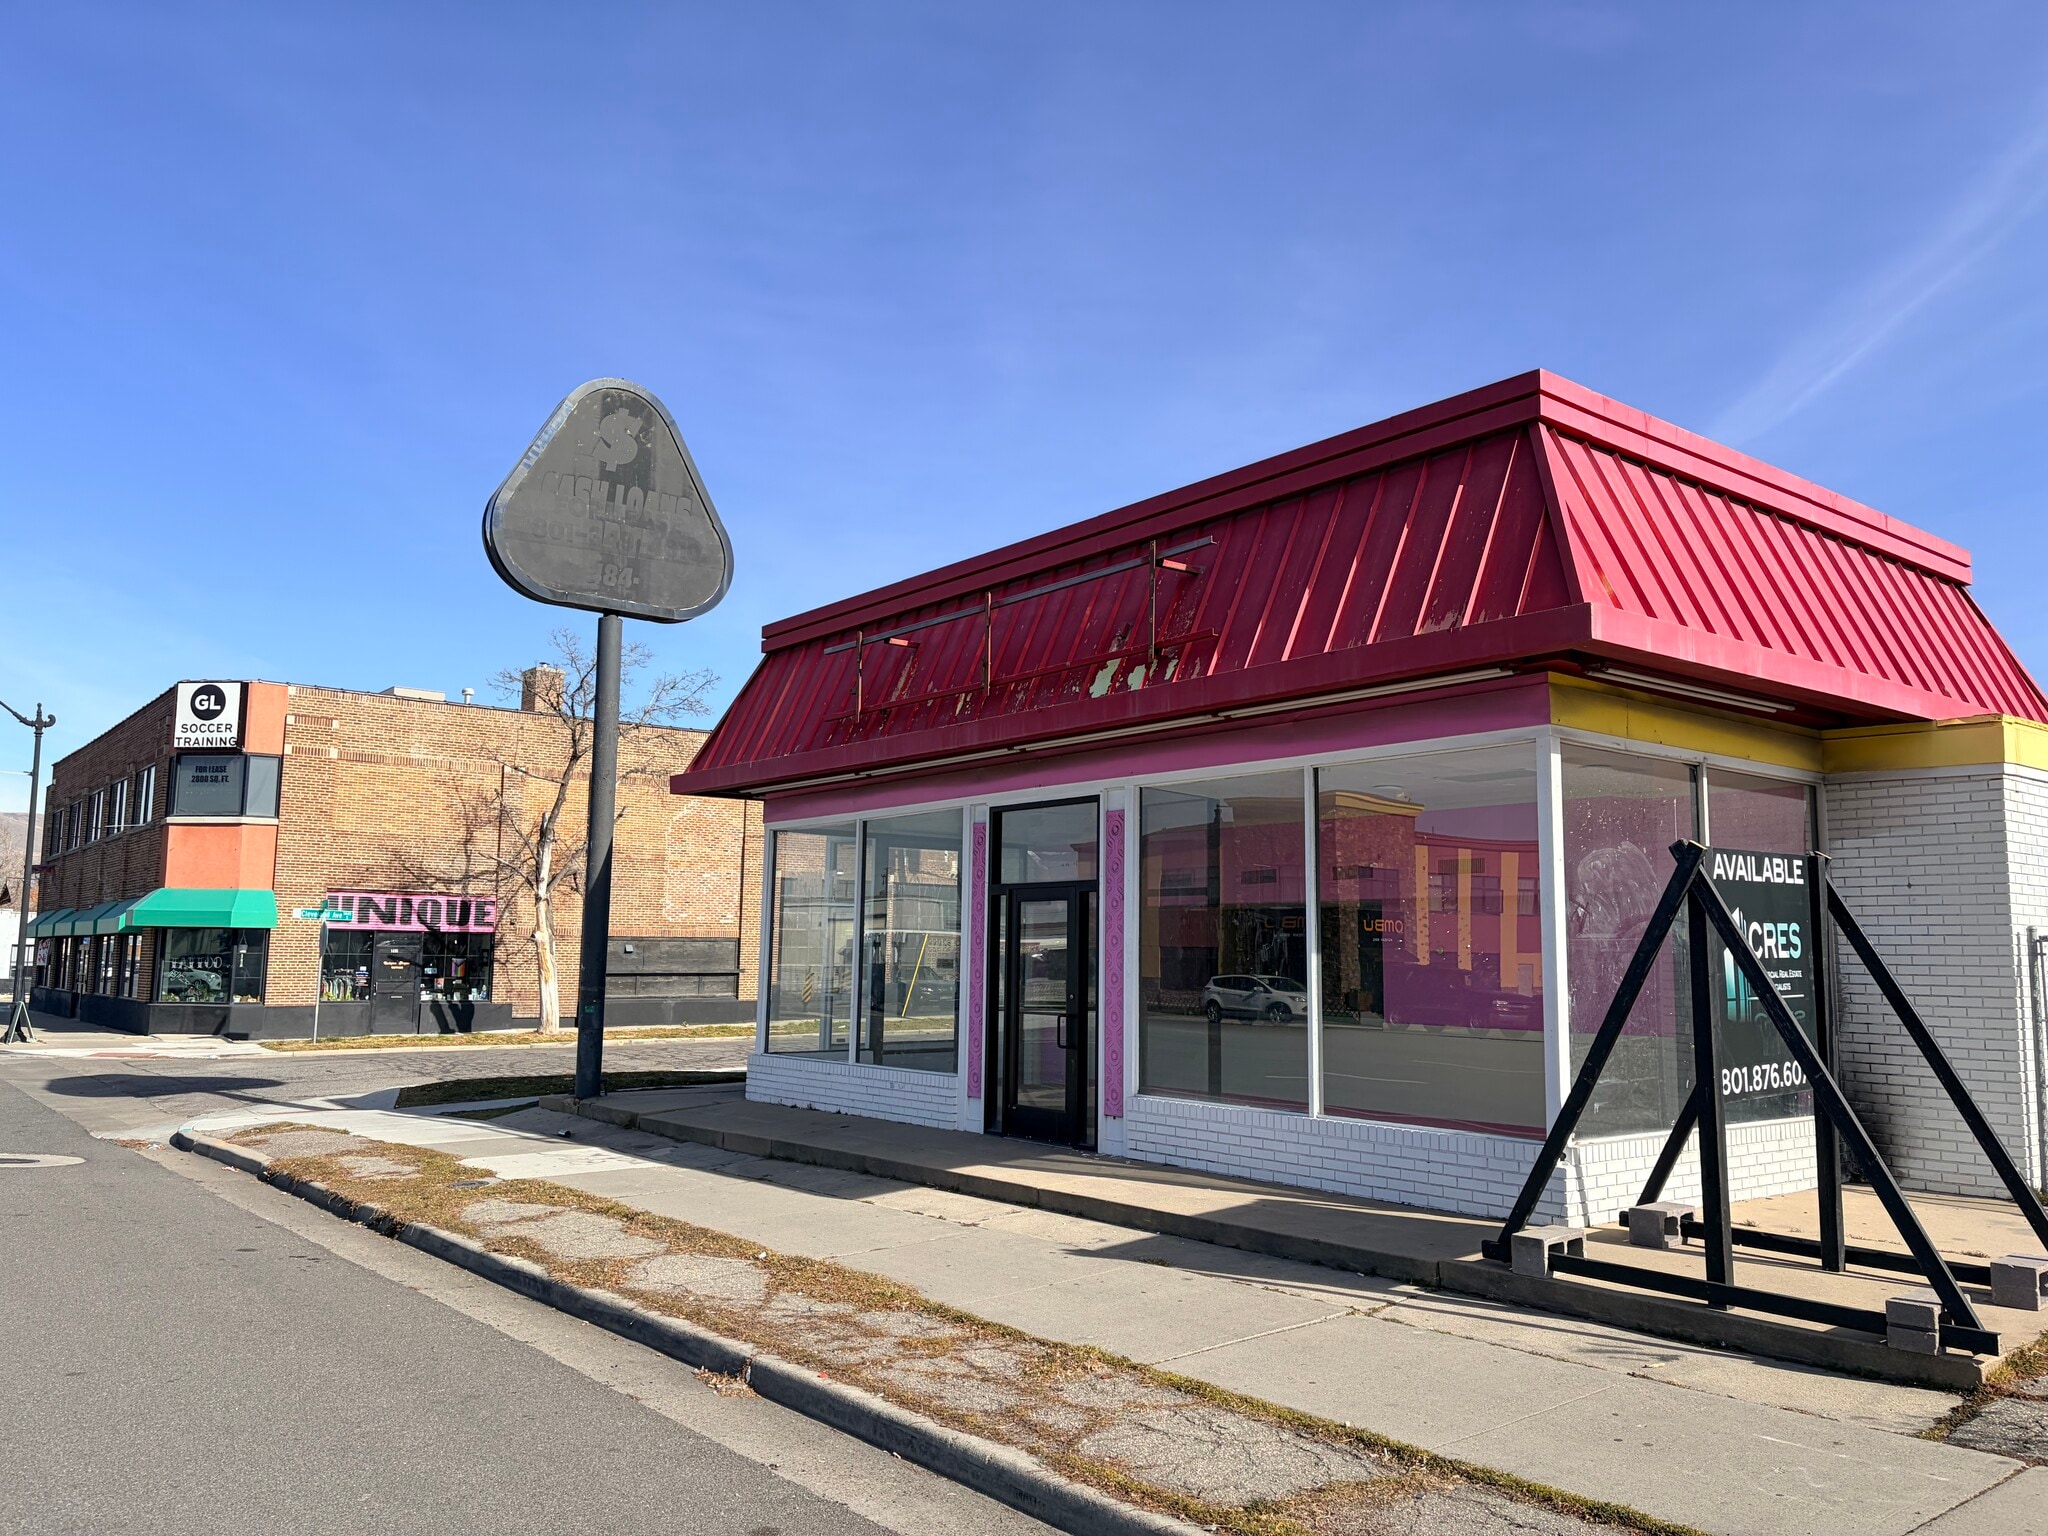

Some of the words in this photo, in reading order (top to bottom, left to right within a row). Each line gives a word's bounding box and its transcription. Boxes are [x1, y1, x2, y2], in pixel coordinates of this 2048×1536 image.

[194, 694, 221, 711] GL
[180, 723, 233, 733] SOCCER
[176, 736, 237, 746] TRAINING
[195, 765, 207, 773] FOR
[208, 765, 227, 773] LEASE
[1713, 853, 1804, 885] AVAILABLE
[328, 895, 495, 929] UNIQUE
[332, 911, 343, 919] Ave
[1748, 921, 1802, 960] CRES
[1721, 1061, 1807, 1096] 801.876.60
